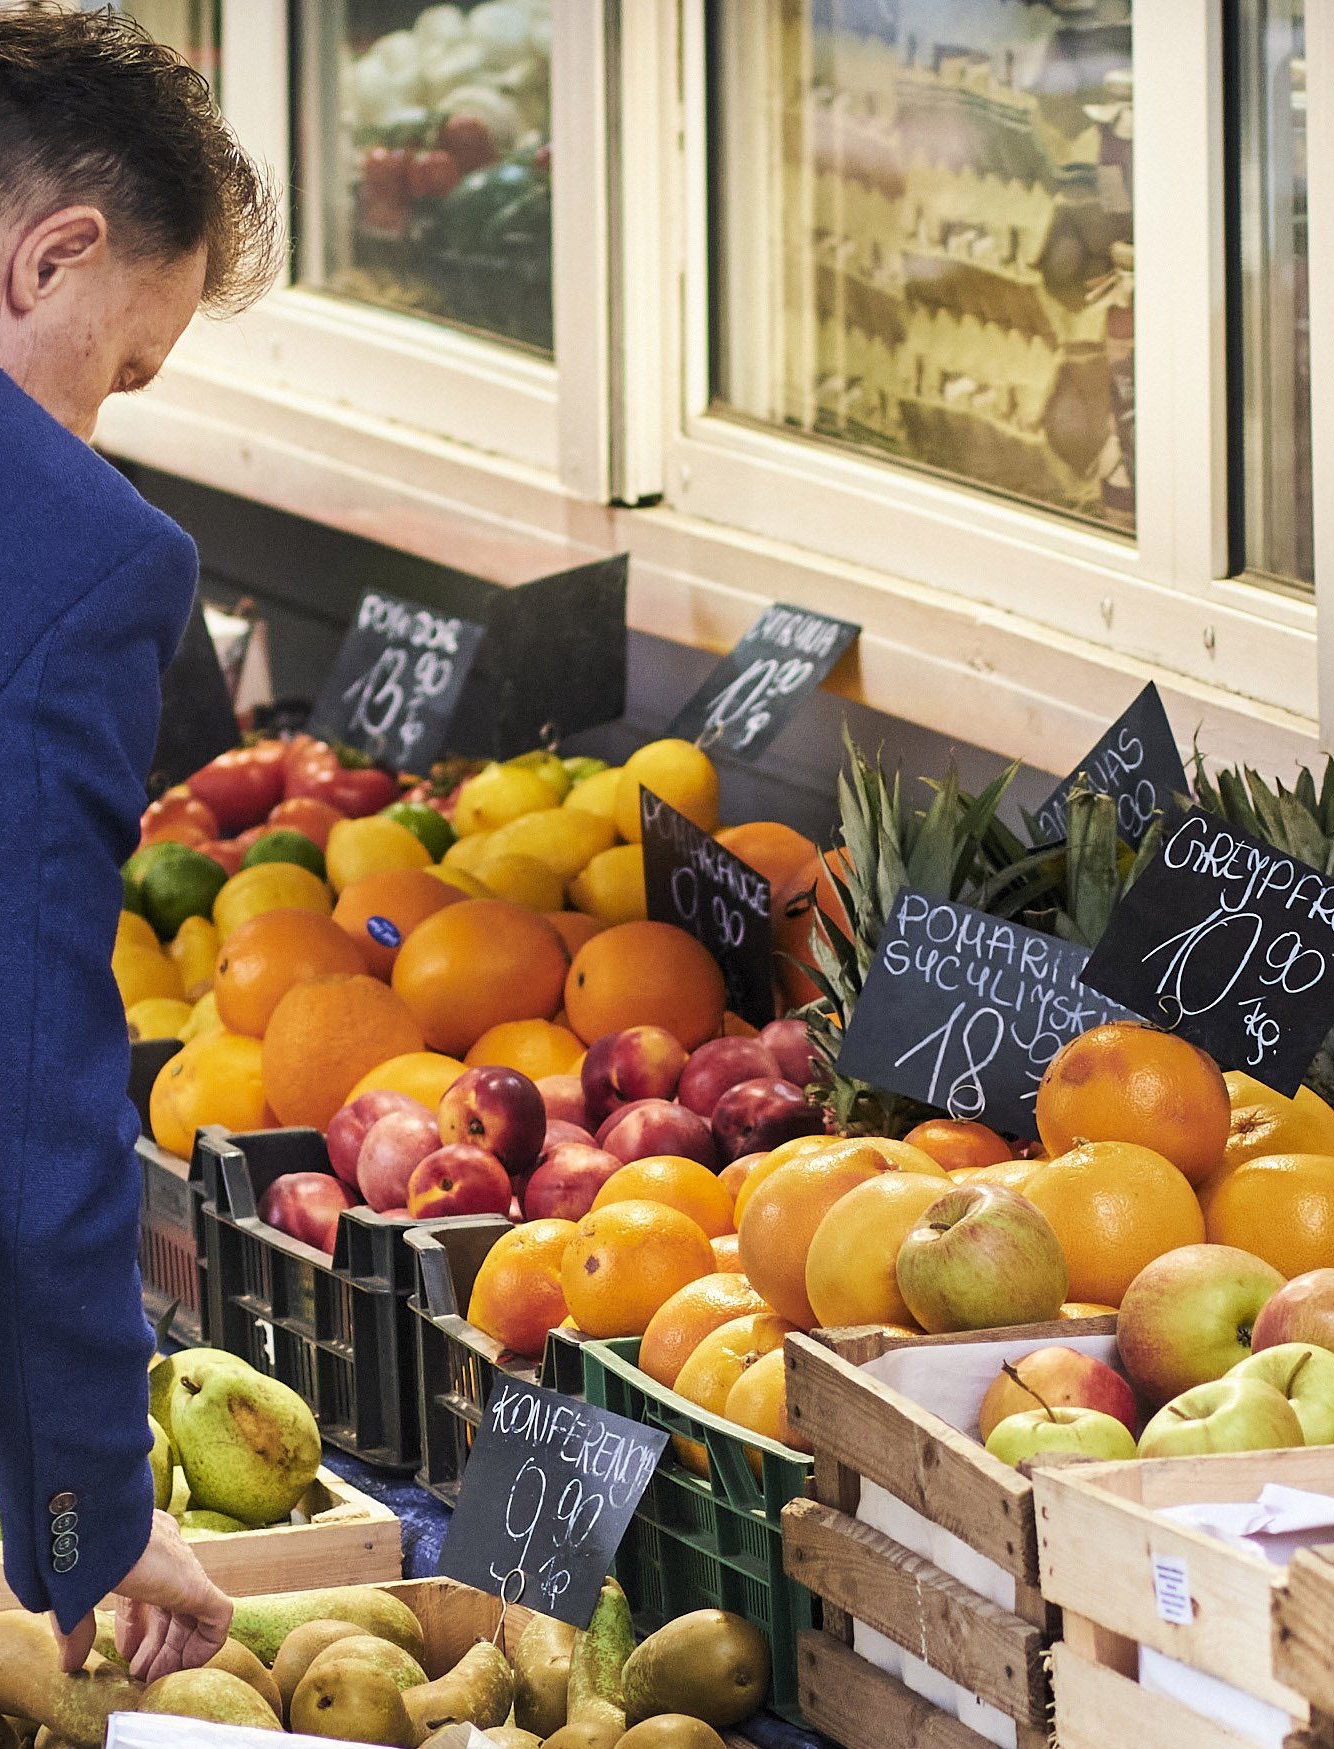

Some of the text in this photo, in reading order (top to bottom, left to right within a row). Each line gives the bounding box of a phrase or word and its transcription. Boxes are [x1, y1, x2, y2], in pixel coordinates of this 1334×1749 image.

[1141, 907, 1327, 1017] 10 90
[893, 1001, 1005, 1112] 18
[551, 1478, 605, 1549] 90
